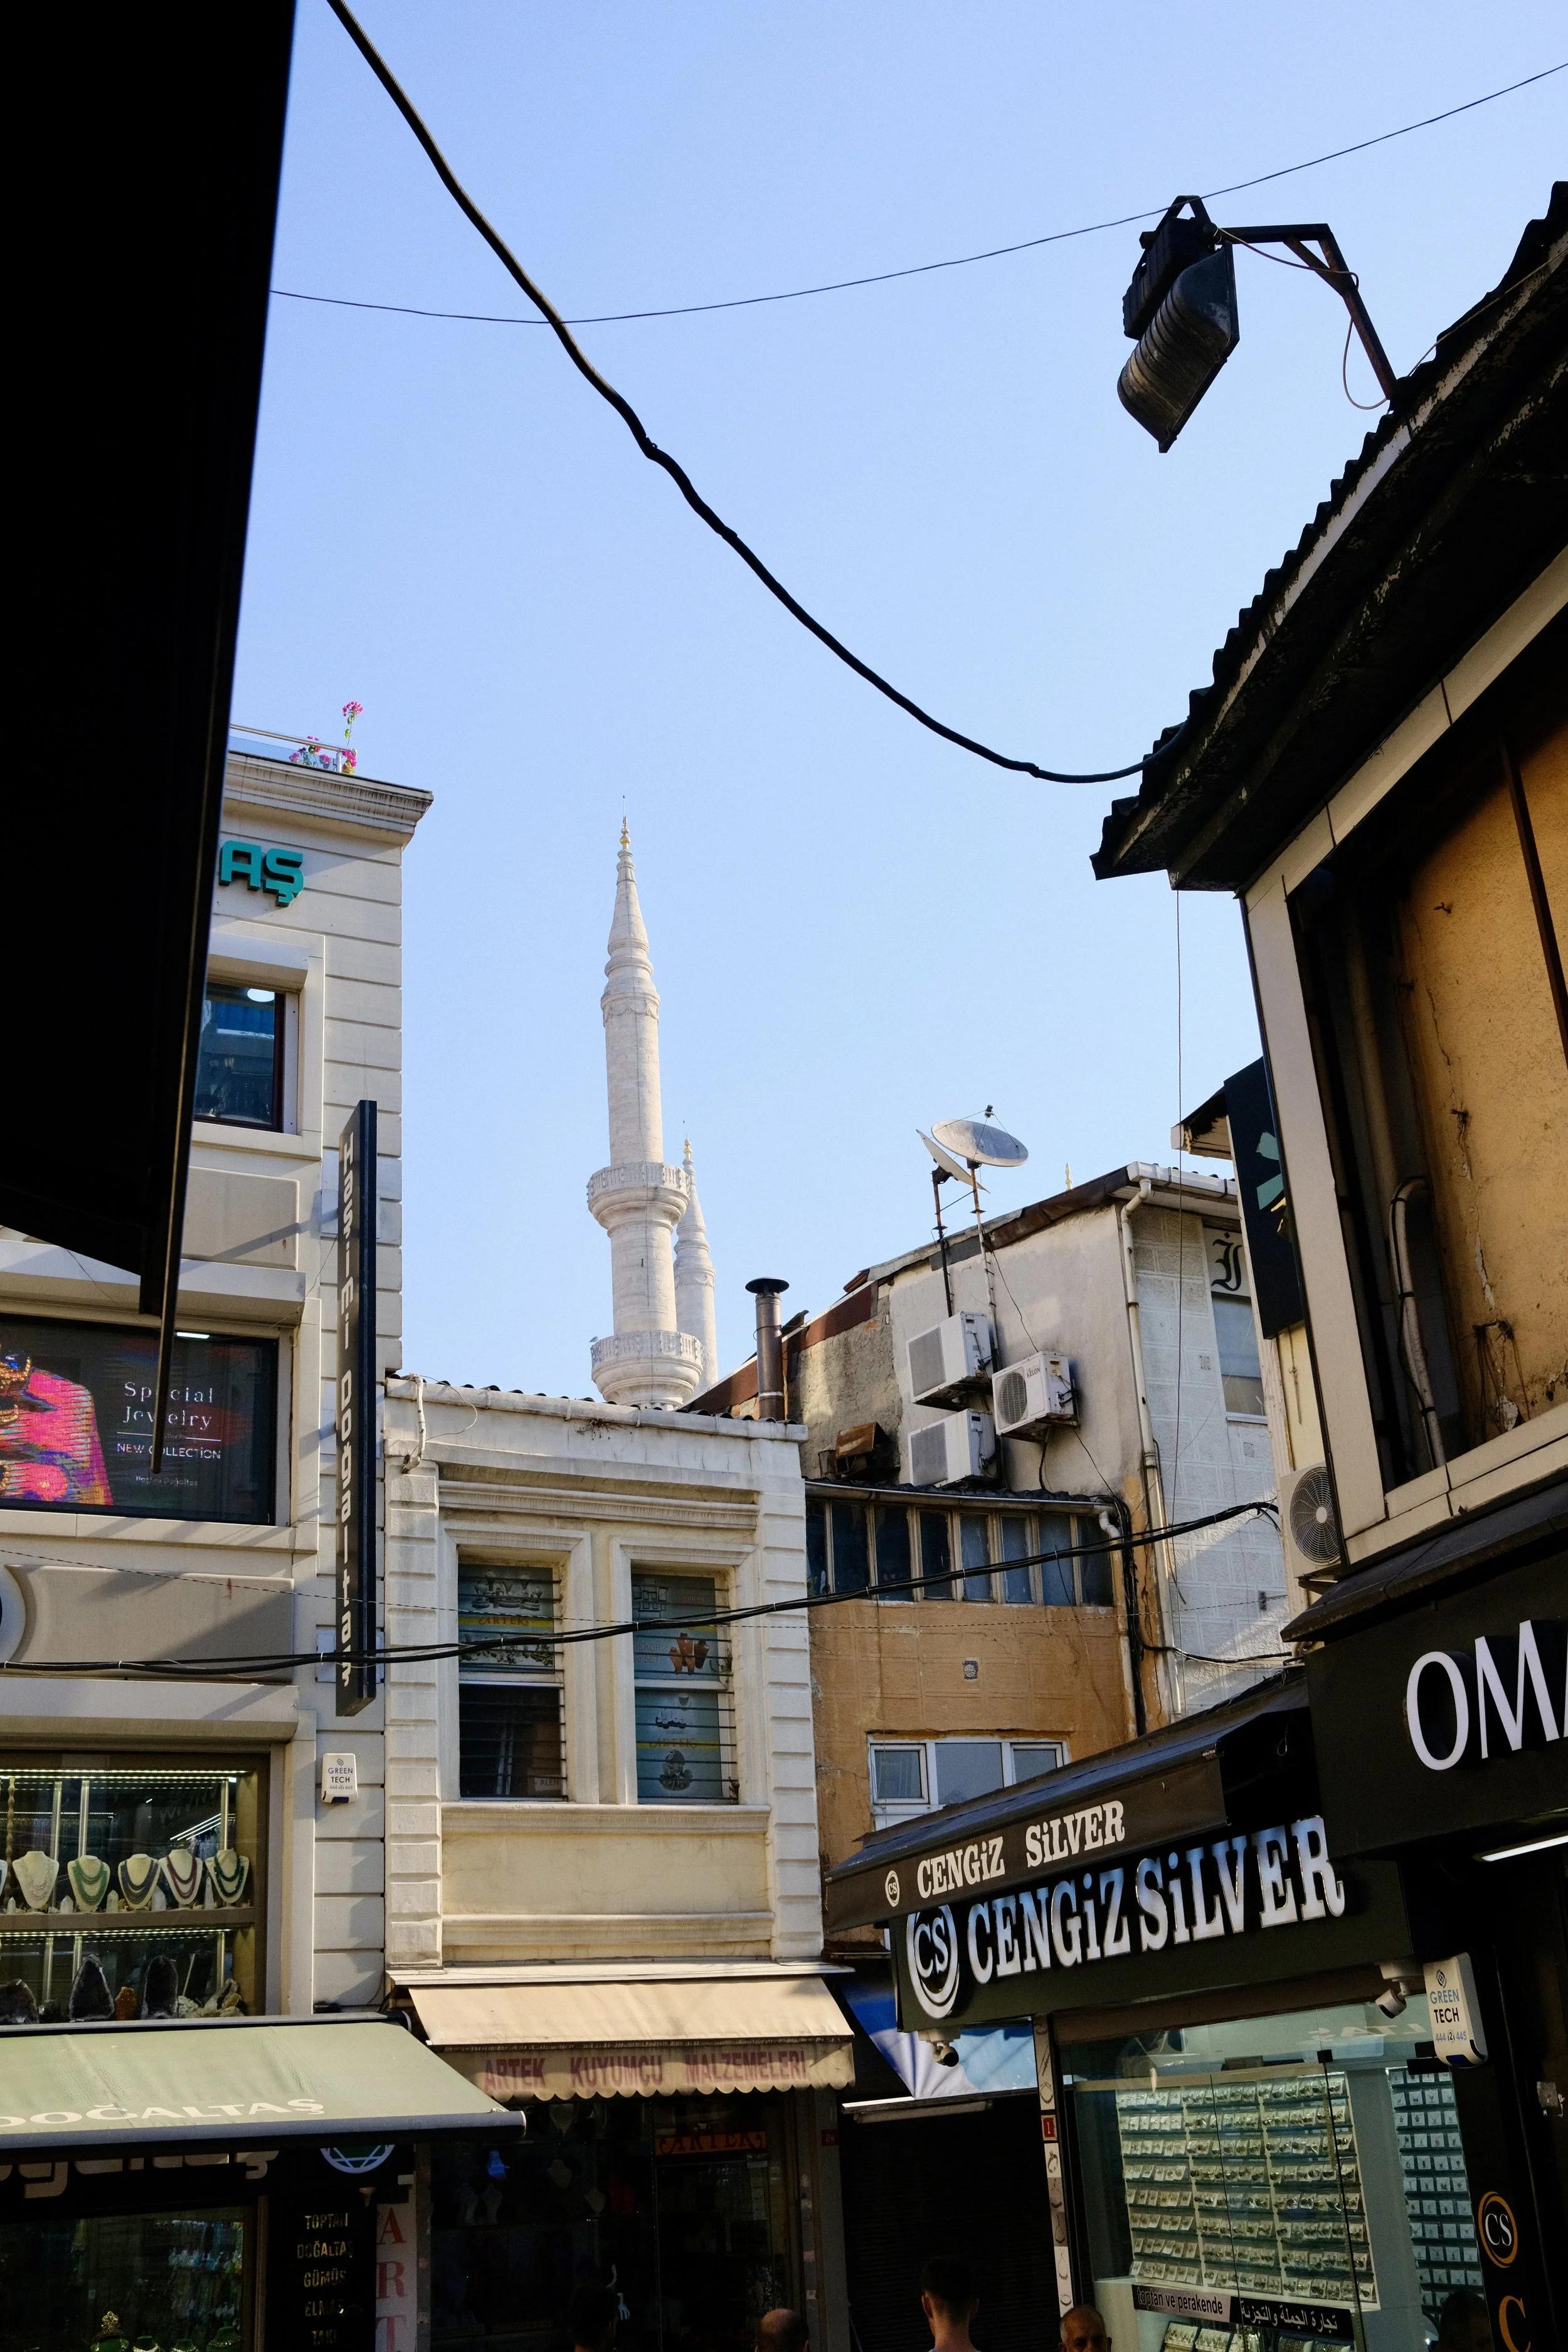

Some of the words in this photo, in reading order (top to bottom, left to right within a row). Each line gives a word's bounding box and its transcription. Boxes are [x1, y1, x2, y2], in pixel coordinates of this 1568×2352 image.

[124, 1382, 213, 1402] Spcial
[117, 1443, 146, 1454] NEW
[478, 1617, 529, 1626] ARTEK
[1406, 1619, 1568, 1771] OM
[914, 1917, 949, 1978] CS
[1430, 1989, 1460, 2005] GREEN
[1434, 2008, 1460, 2023] TECH
[1436, 2033, 1446, 2042] 444
[1456, 2032, 1467, 2041] 445
[484, 2058, 546, 2092] ARTEK
[570, 2055, 663, 2091] KUYUMCU
[305, 2212, 348, 2230] TOPTAN
[1485, 2213, 1512, 2246] CS
[1136, 2286, 1164, 2307] toptan
[1165, 2294, 1176, 2308] ve
[1178, 2293, 1224, 2316] perakende
[1279, 2304, 1308, 2329] الجملة
[1310, 2311, 1338, 2333] تجارة
